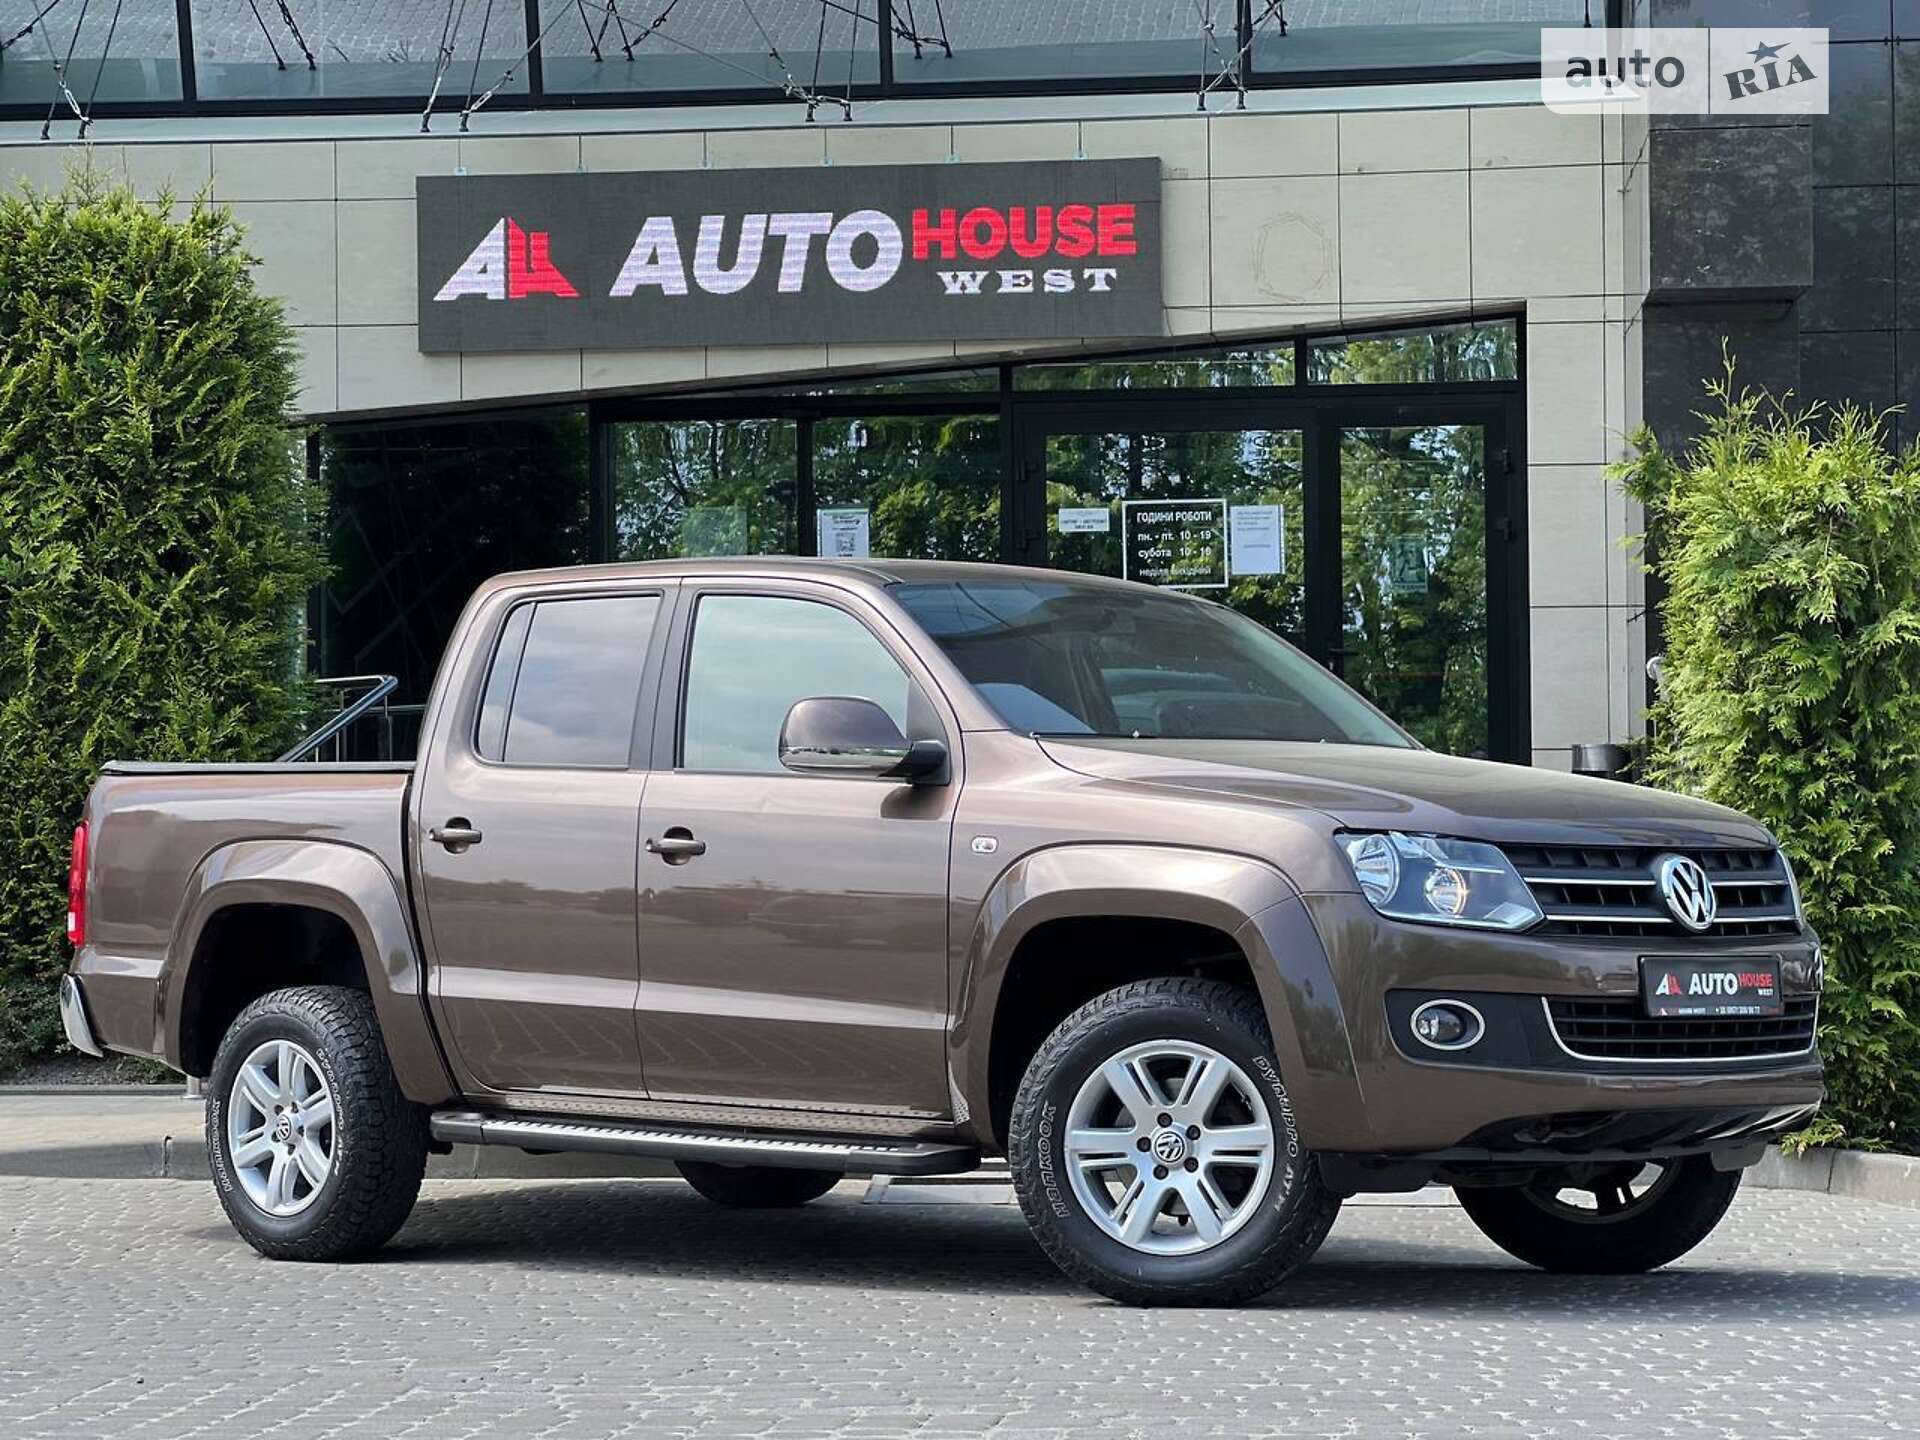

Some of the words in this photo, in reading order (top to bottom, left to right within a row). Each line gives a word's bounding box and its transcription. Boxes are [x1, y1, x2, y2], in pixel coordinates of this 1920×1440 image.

[609, 209, 903, 297] AUTO
[912, 203, 1136, 260] HOUSE
[936, 268, 1117, 295] WEST
[1136, 511, 1174, 524] ГОДИНИ
[1175, 511, 1212, 522] РОБОТИ
[1179, 530, 1191, 540] 10
[1200, 530, 1212, 540] 19
[1138, 547, 1172, 559] субота
[1179, 547, 1191, 557] 10
[1688, 972, 1738, 995] AUTO
[1738, 972, 1773, 987] HOUSE
